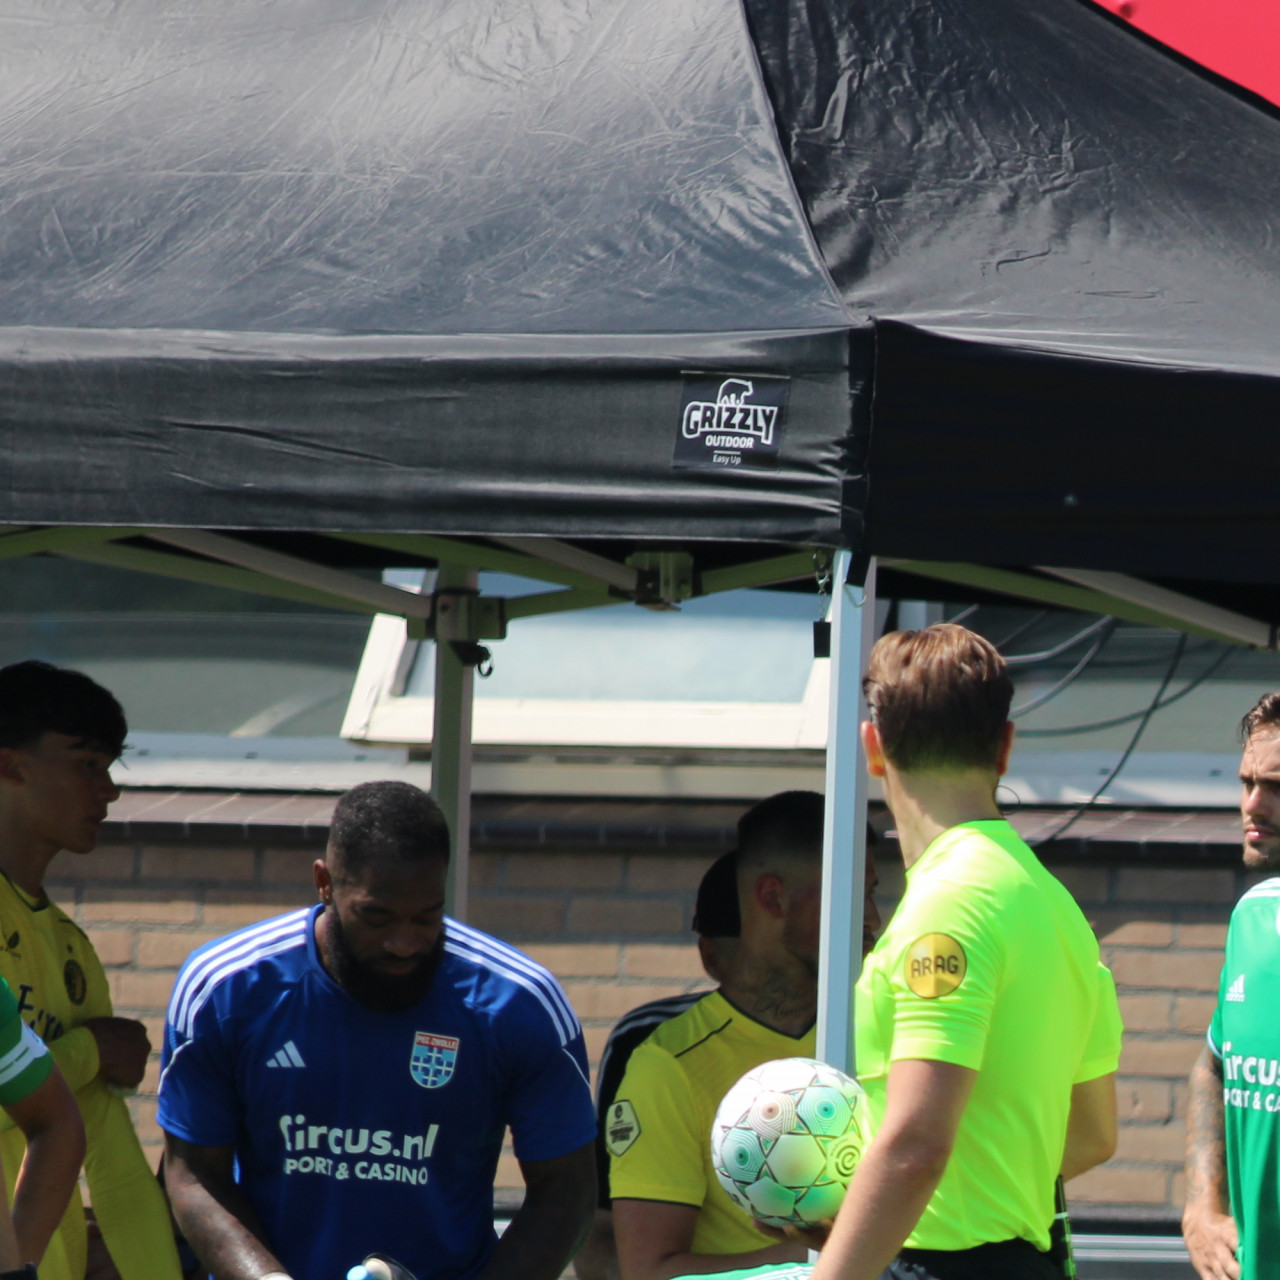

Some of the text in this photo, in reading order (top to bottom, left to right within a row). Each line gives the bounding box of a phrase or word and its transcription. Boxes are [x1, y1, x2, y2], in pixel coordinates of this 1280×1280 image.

[682, 400, 778, 445] GRIZZLY
[705, 434, 755, 449] OUTDOOR
[712, 454, 742, 466] Easy Up
[910, 954, 959, 979] ARAG
[1252, 1091, 1261, 1110] &
[335, 1162, 349, 1180] &
[354, 1161, 428, 1185] CASINO
